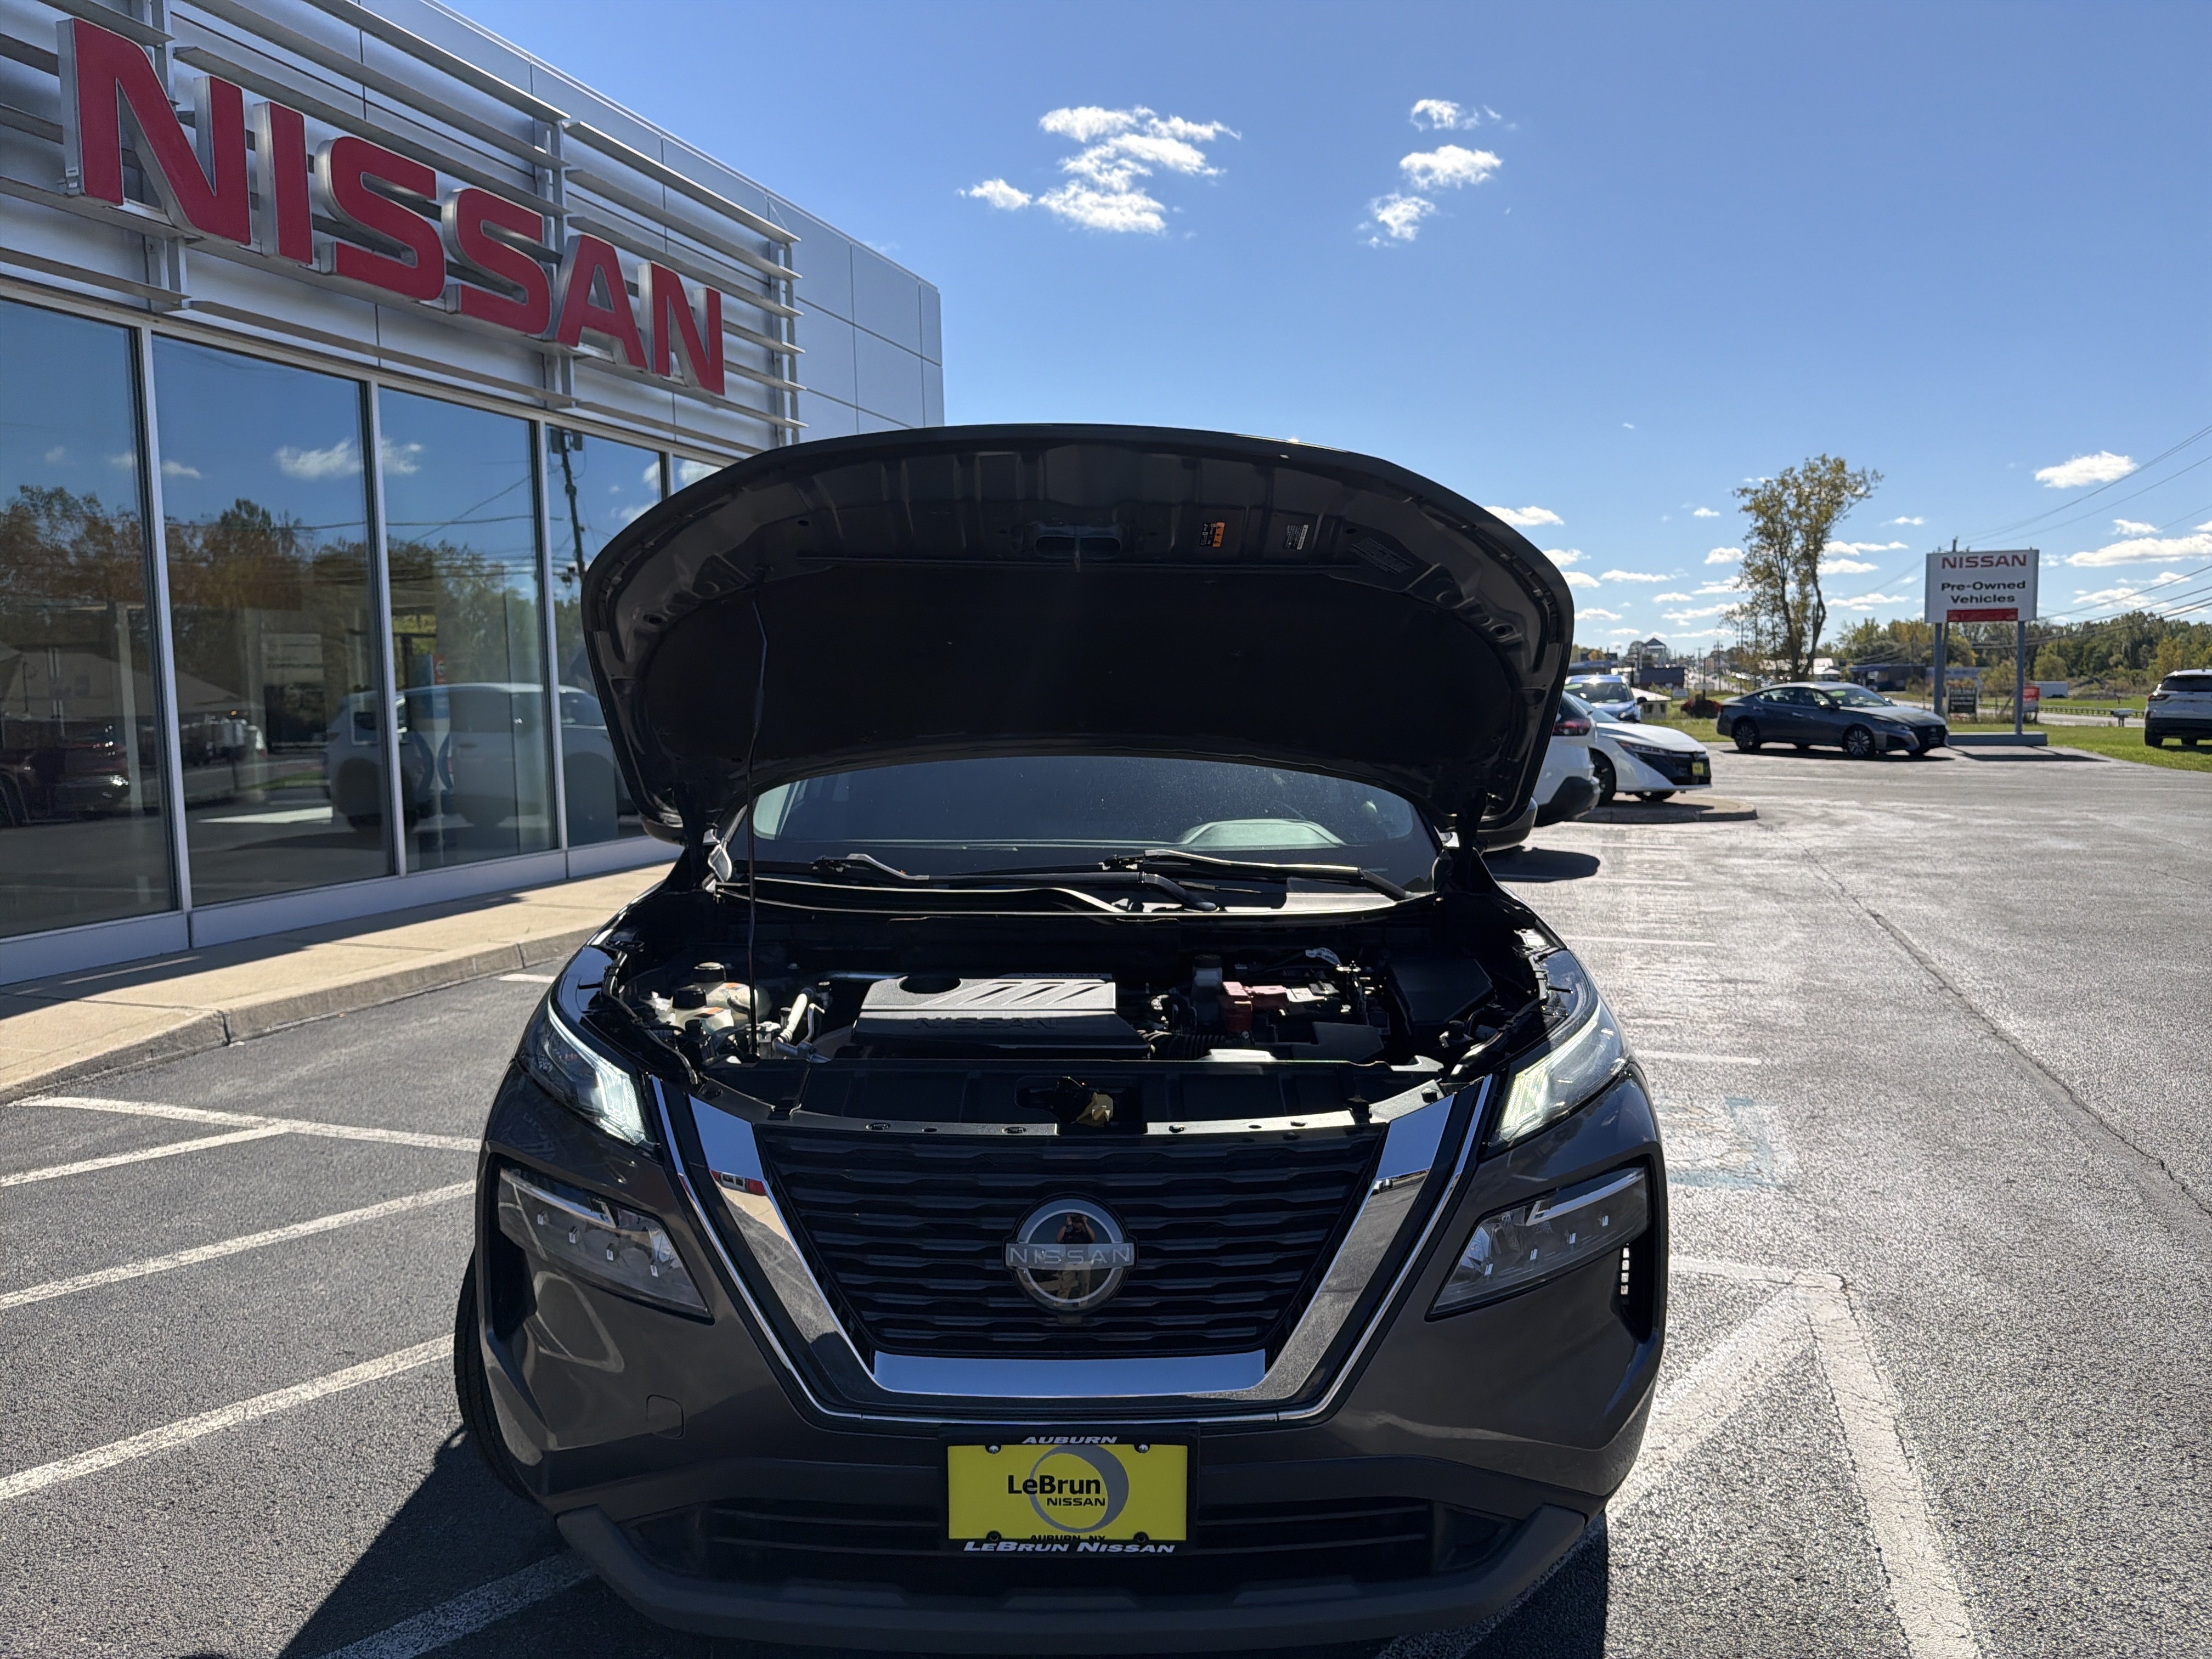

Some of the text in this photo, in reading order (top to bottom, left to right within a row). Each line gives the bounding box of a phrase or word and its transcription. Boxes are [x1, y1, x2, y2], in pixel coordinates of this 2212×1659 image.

[57, 18, 725, 396] NISSAN
[1942, 554, 2027, 569] NISSAN
[1941, 580, 2025, 591] Pre-Owned
[1951, 594, 2015, 603] Vehicles
[915, 1018, 1057, 1029] NISSAN
[1009, 1248, 1130, 1264] NISSAN
[1022, 1436, 1118, 1444] AUBURN
[1007, 1475, 1101, 1496] LeBrun
[1047, 1498, 1105, 1506] NISSAN
